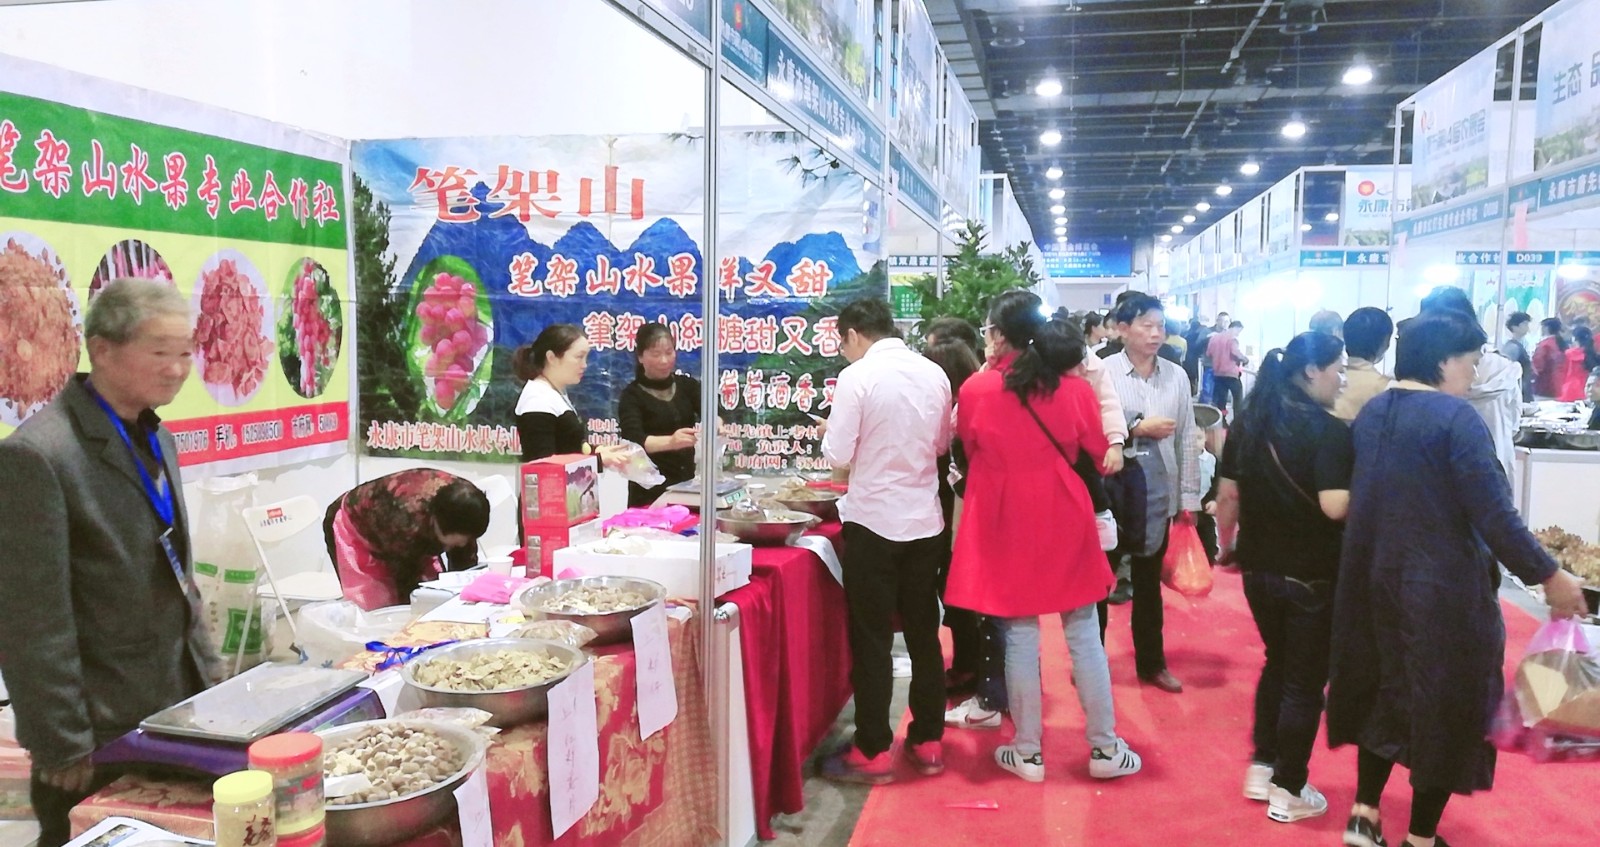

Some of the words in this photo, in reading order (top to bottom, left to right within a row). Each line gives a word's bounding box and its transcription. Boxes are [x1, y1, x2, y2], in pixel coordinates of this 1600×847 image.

[1552, 62, 1583, 105] 生态
[0, 119, 340, 227] 笔架山水果专业合作社
[407, 164, 646, 223] 笔架山
[1516, 253, 1543, 263] D039
[366, 420, 524, 456] 永康市笔架山水果专业
